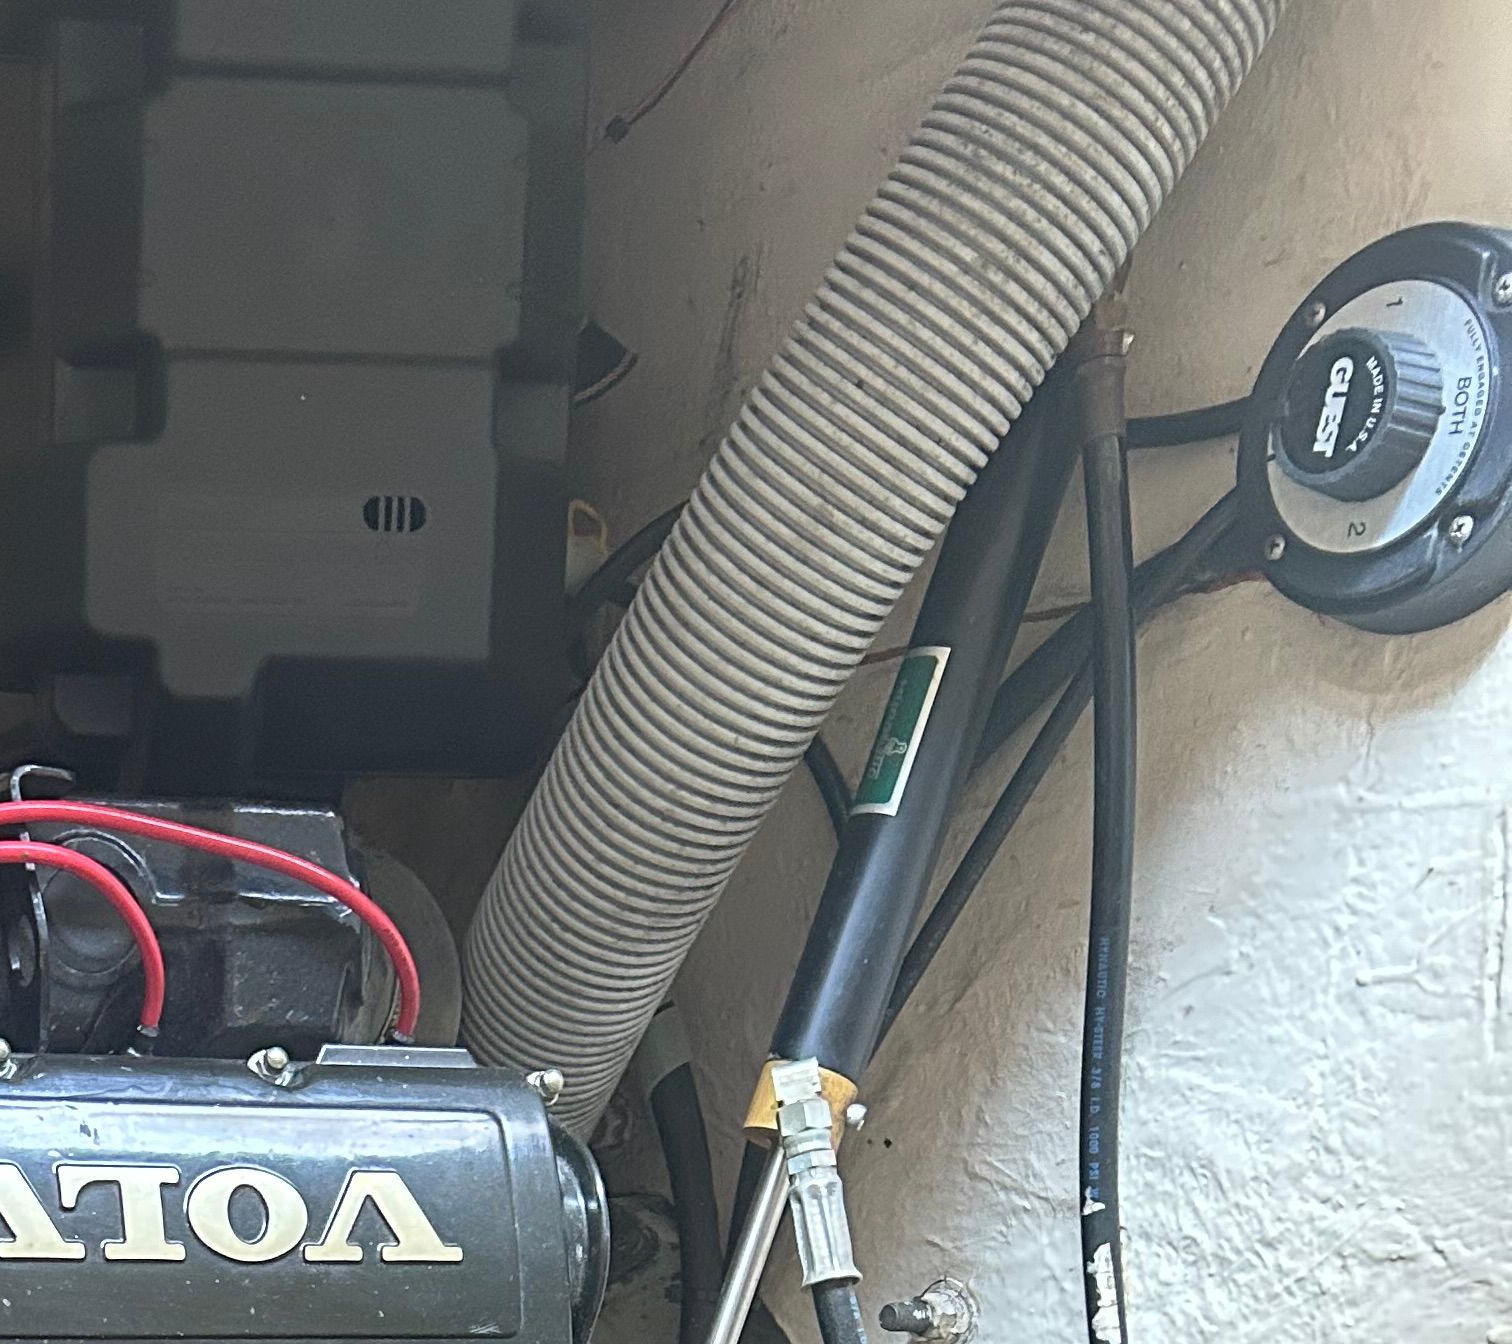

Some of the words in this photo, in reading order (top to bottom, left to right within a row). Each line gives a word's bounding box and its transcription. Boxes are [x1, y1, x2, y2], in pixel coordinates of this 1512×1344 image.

[1462, 318, 1482, 353] FULLY
[1366, 356, 1384, 395] MADE
[1312, 356, 1353, 458] GUEST
[1371, 399, 1384, 413] IN
[1448, 376, 1472, 435] BOTH
[1348, 522, 1367, 538] 2
[1091, 1067, 1102, 1089] 3/8
[1088, 1126, 1099, 1154] 1000
[1089, 1163, 1099, 1179] PSI
